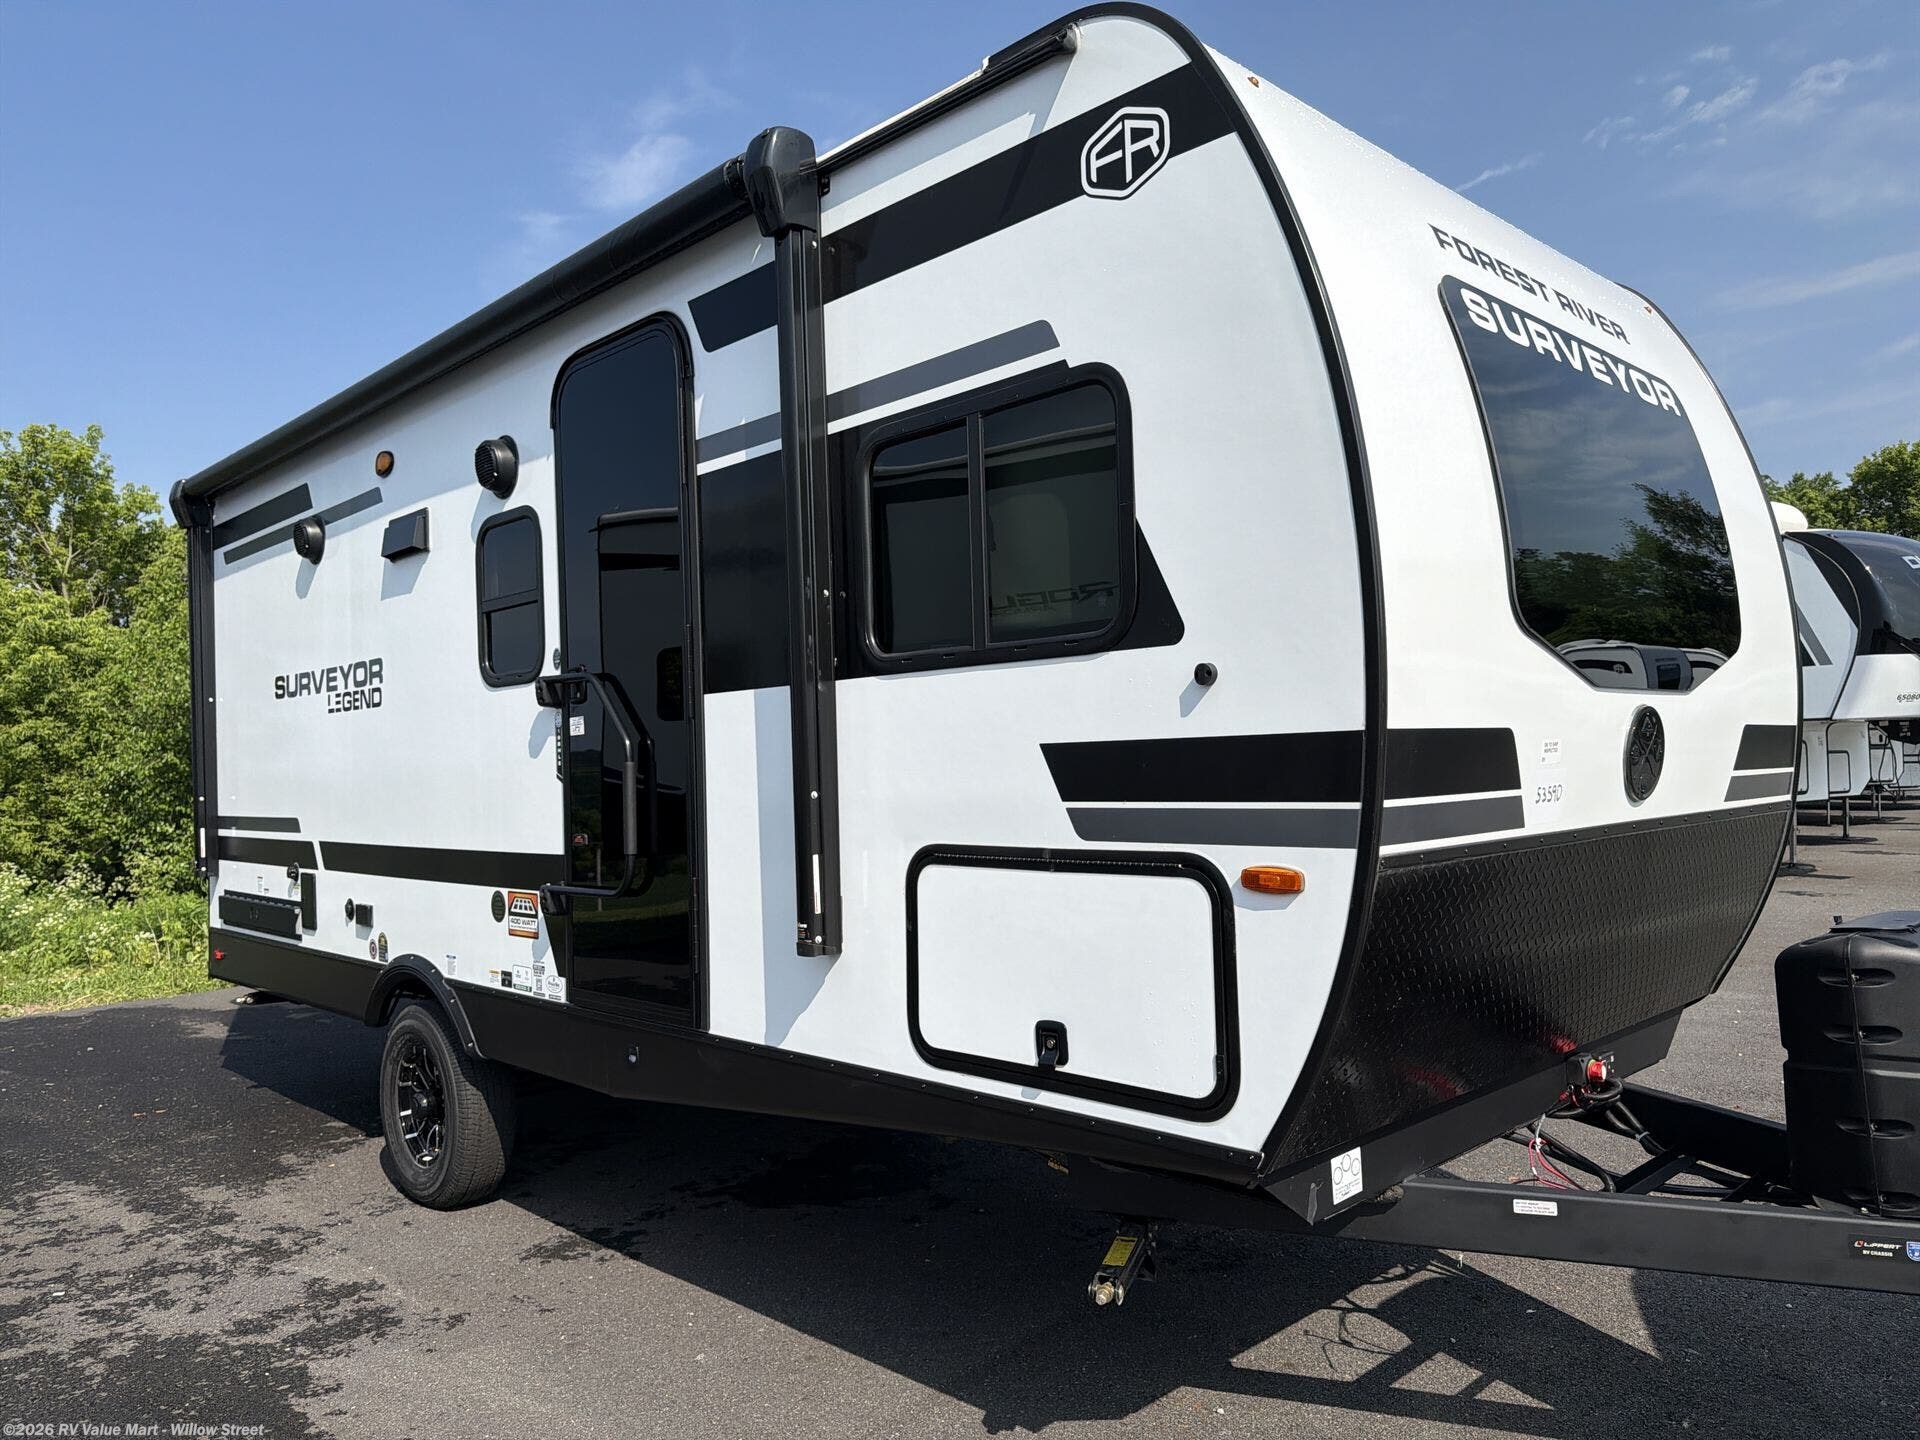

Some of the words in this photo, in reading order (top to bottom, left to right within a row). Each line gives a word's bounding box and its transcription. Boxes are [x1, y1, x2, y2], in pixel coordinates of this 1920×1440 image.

[1426, 222, 1550, 303] FOREST
[1551, 288, 1631, 346] RIVER
[1460, 287, 1682, 417] SURVEYOR
[274, 657, 384, 700] SURVEYOR
[327, 687, 382, 714] LEGEND
